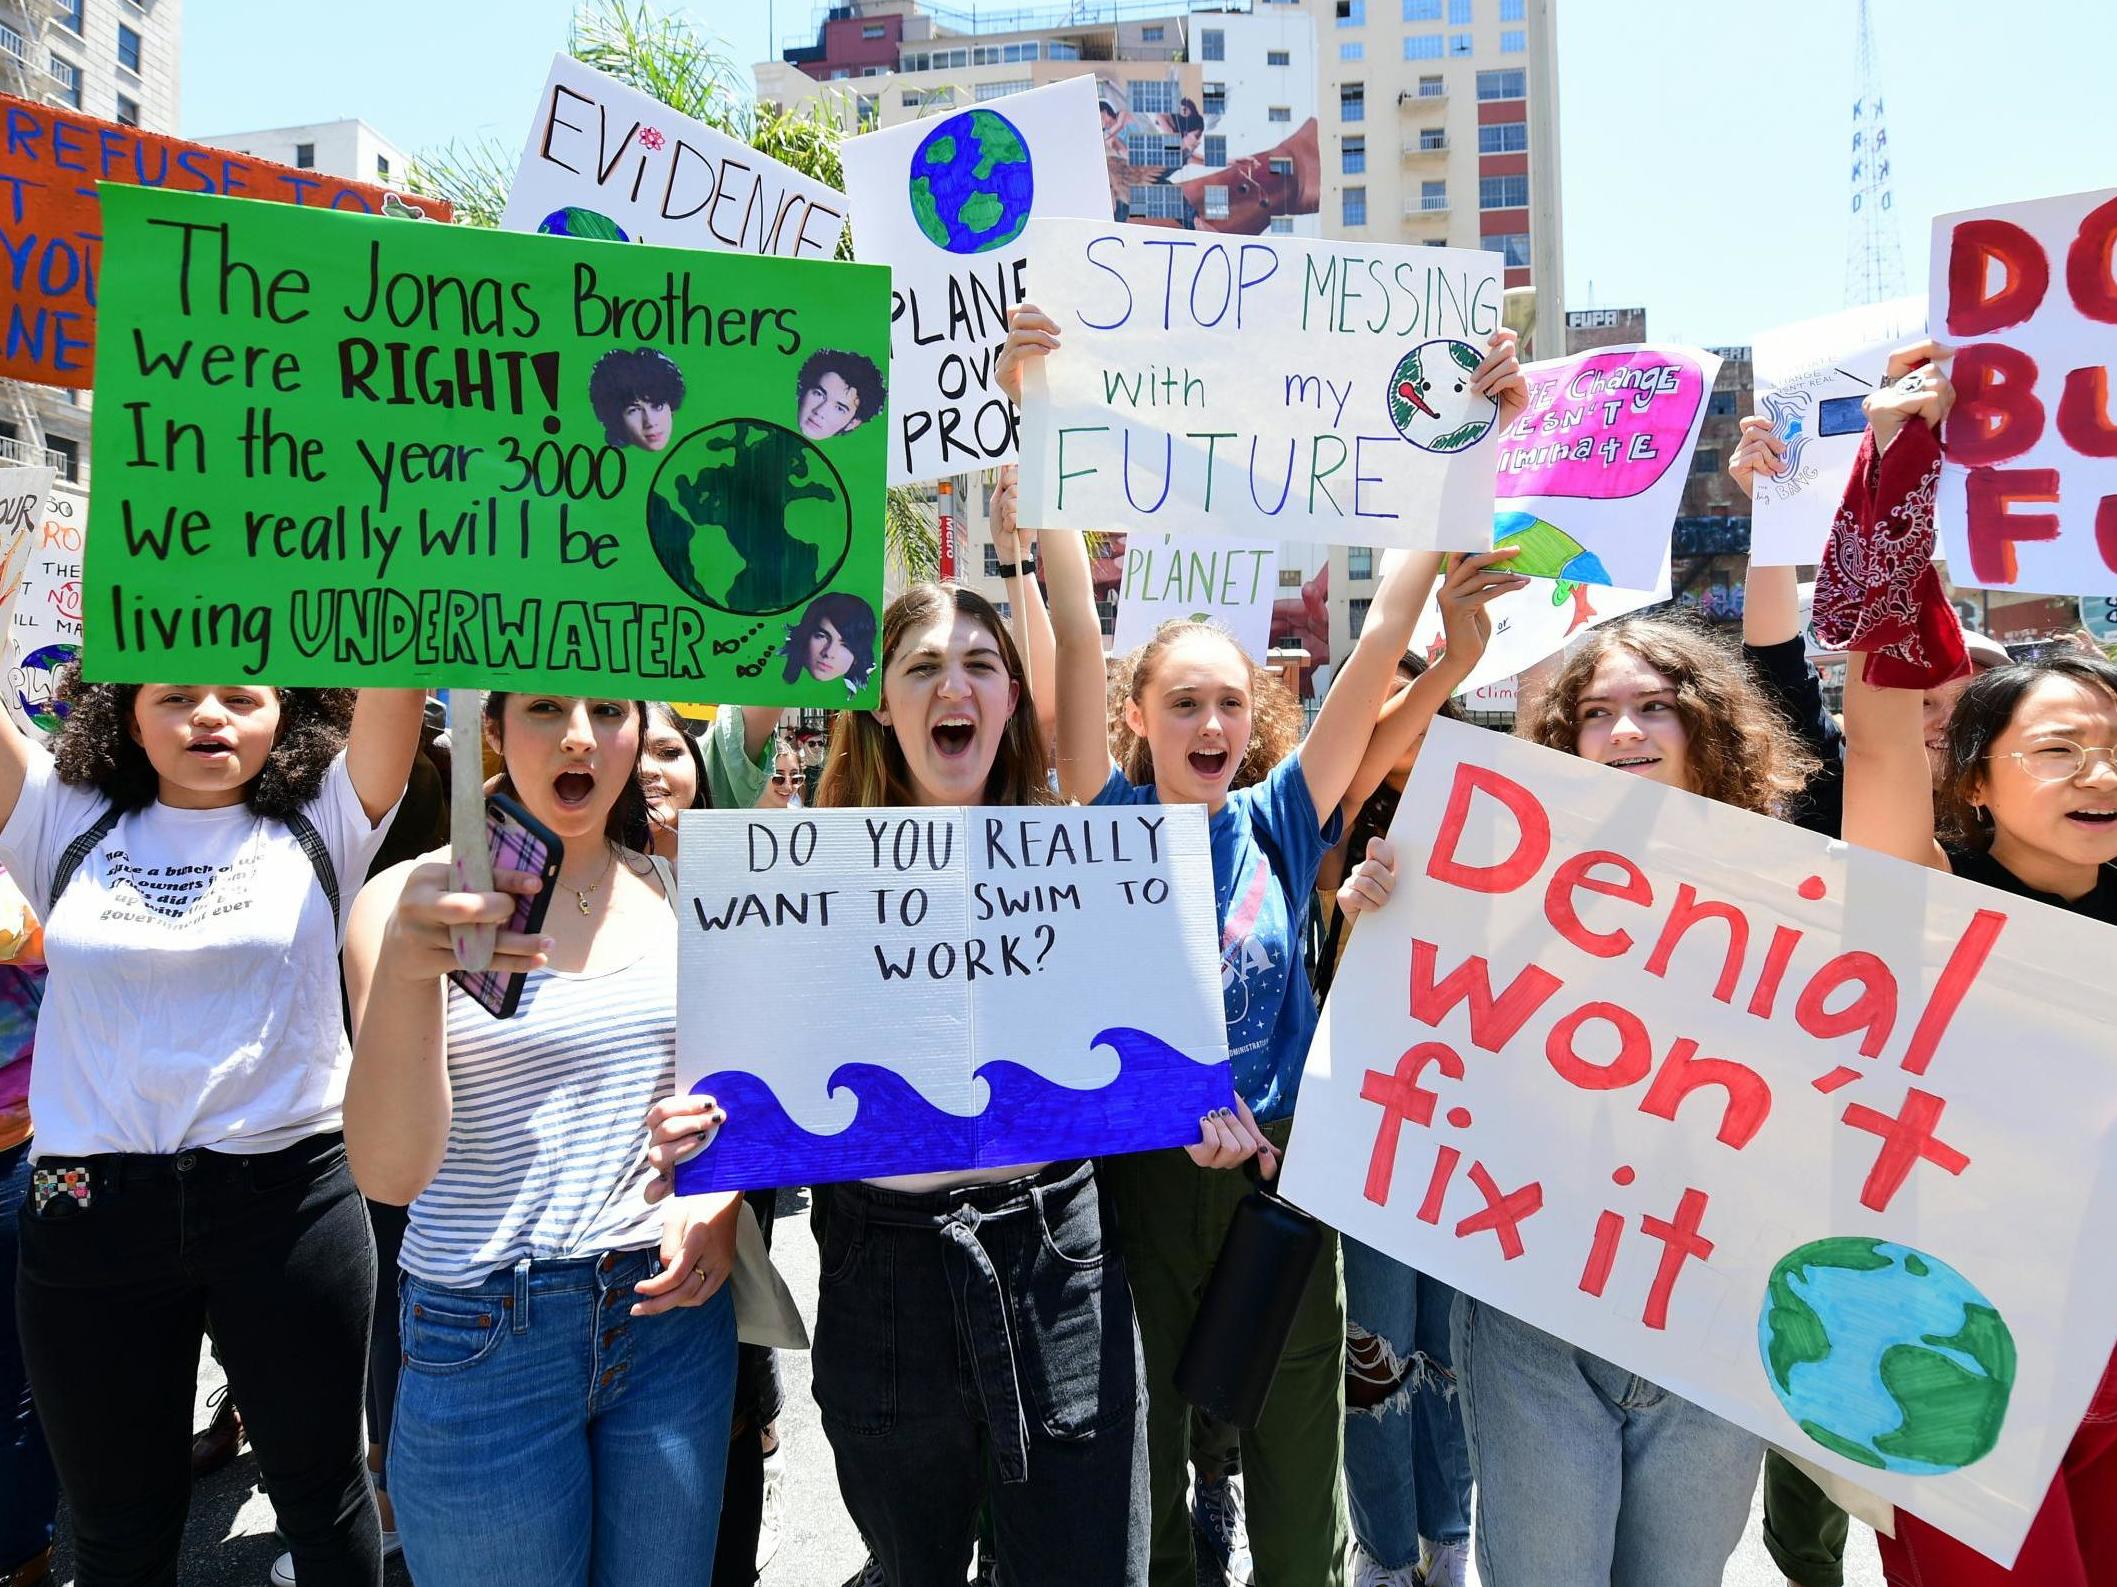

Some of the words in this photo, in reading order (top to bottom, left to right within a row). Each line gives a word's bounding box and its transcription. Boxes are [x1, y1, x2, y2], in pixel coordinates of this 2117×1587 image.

[147, 218, 310, 324] The
[344, 240, 541, 338] Jonas
[574, 262, 801, 356] Brothers
[1076, 236, 1279, 331] STOP
[1302, 252, 1498, 339] MESSING
[3, 304, 88, 371] NE
[132, 328, 301, 392] were
[338, 336, 560, 435] RIGHT!
[1103, 363, 1205, 408] with
[1285, 373, 1352, 428] my
[122, 402, 206, 474] In
[237, 406, 327, 482] the
[356, 437, 484, 513] year
[498, 436, 627, 500] 3000
[1057, 426, 1401, 519] FUTURE
[245, 505, 402, 580] really
[419, 496, 529, 559] will
[560, 503, 620, 569] be
[1125, 548, 1274, 606] PLANET
[48, 588, 83, 609] NO
[112, 584, 273, 676] living
[289, 587, 706, 680] UNDERWATER
[138, 880, 203, 891] owners
[747, 820, 818, 873] DO
[865, 817, 953, 871] YOU
[985, 815, 1165, 870] REALLY
[693, 890, 840, 932] WANT
[869, 888, 928, 927] TO
[974, 882, 1082, 921] SWIM
[1117, 877, 1169, 905] TO
[1425, 762, 2008, 1076] Denial
[874, 924, 1057, 982] WORK?
[1410, 938, 1972, 1213] won't
[1359, 1041, 1544, 1262] fix
[1578, 1165, 1715, 1331] it
